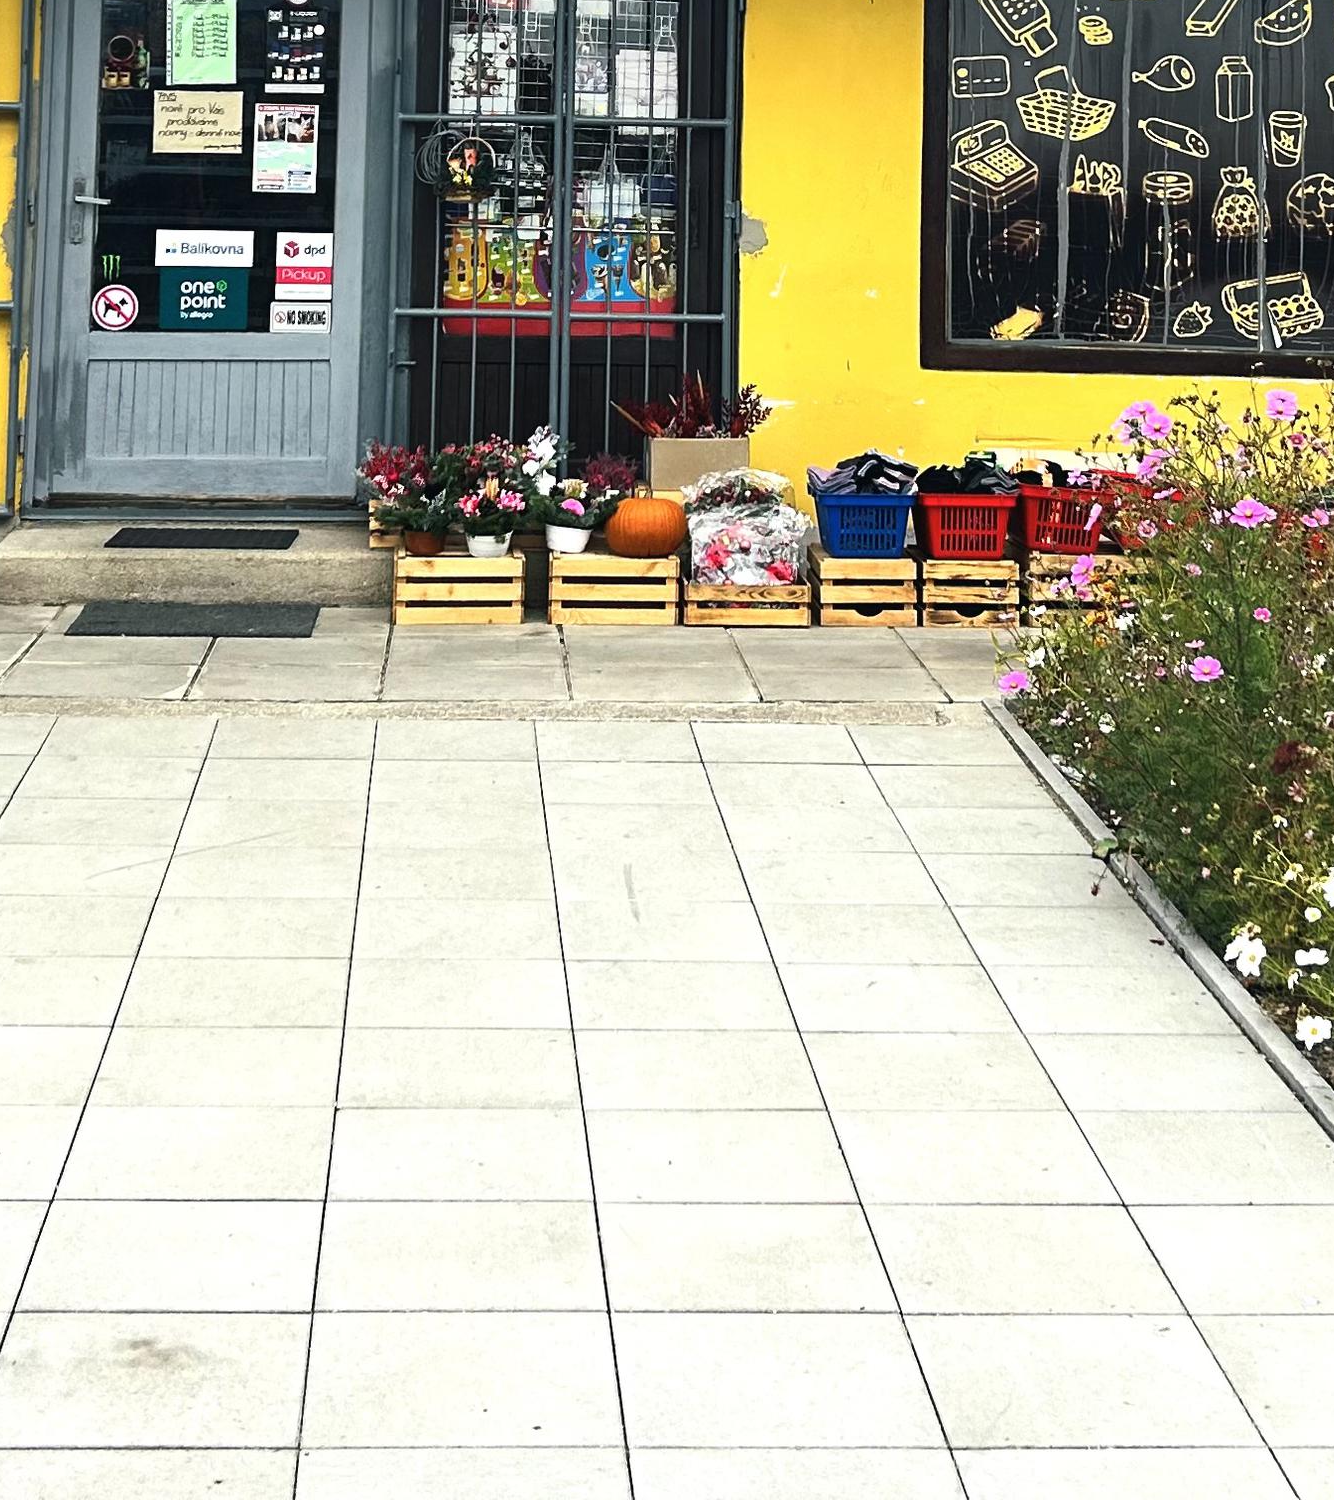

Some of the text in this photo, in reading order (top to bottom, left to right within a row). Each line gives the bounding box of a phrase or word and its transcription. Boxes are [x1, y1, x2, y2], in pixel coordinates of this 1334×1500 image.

[180, 242, 244, 255] Balíkovna
[304, 243, 326, 258] dpd
[281, 268, 327, 282] Pickup
[180, 280, 215, 295] one
[180, 294, 227, 310] point
[189, 310, 214, 321] allegro
[286, 309, 327, 326] NO SMOKING
